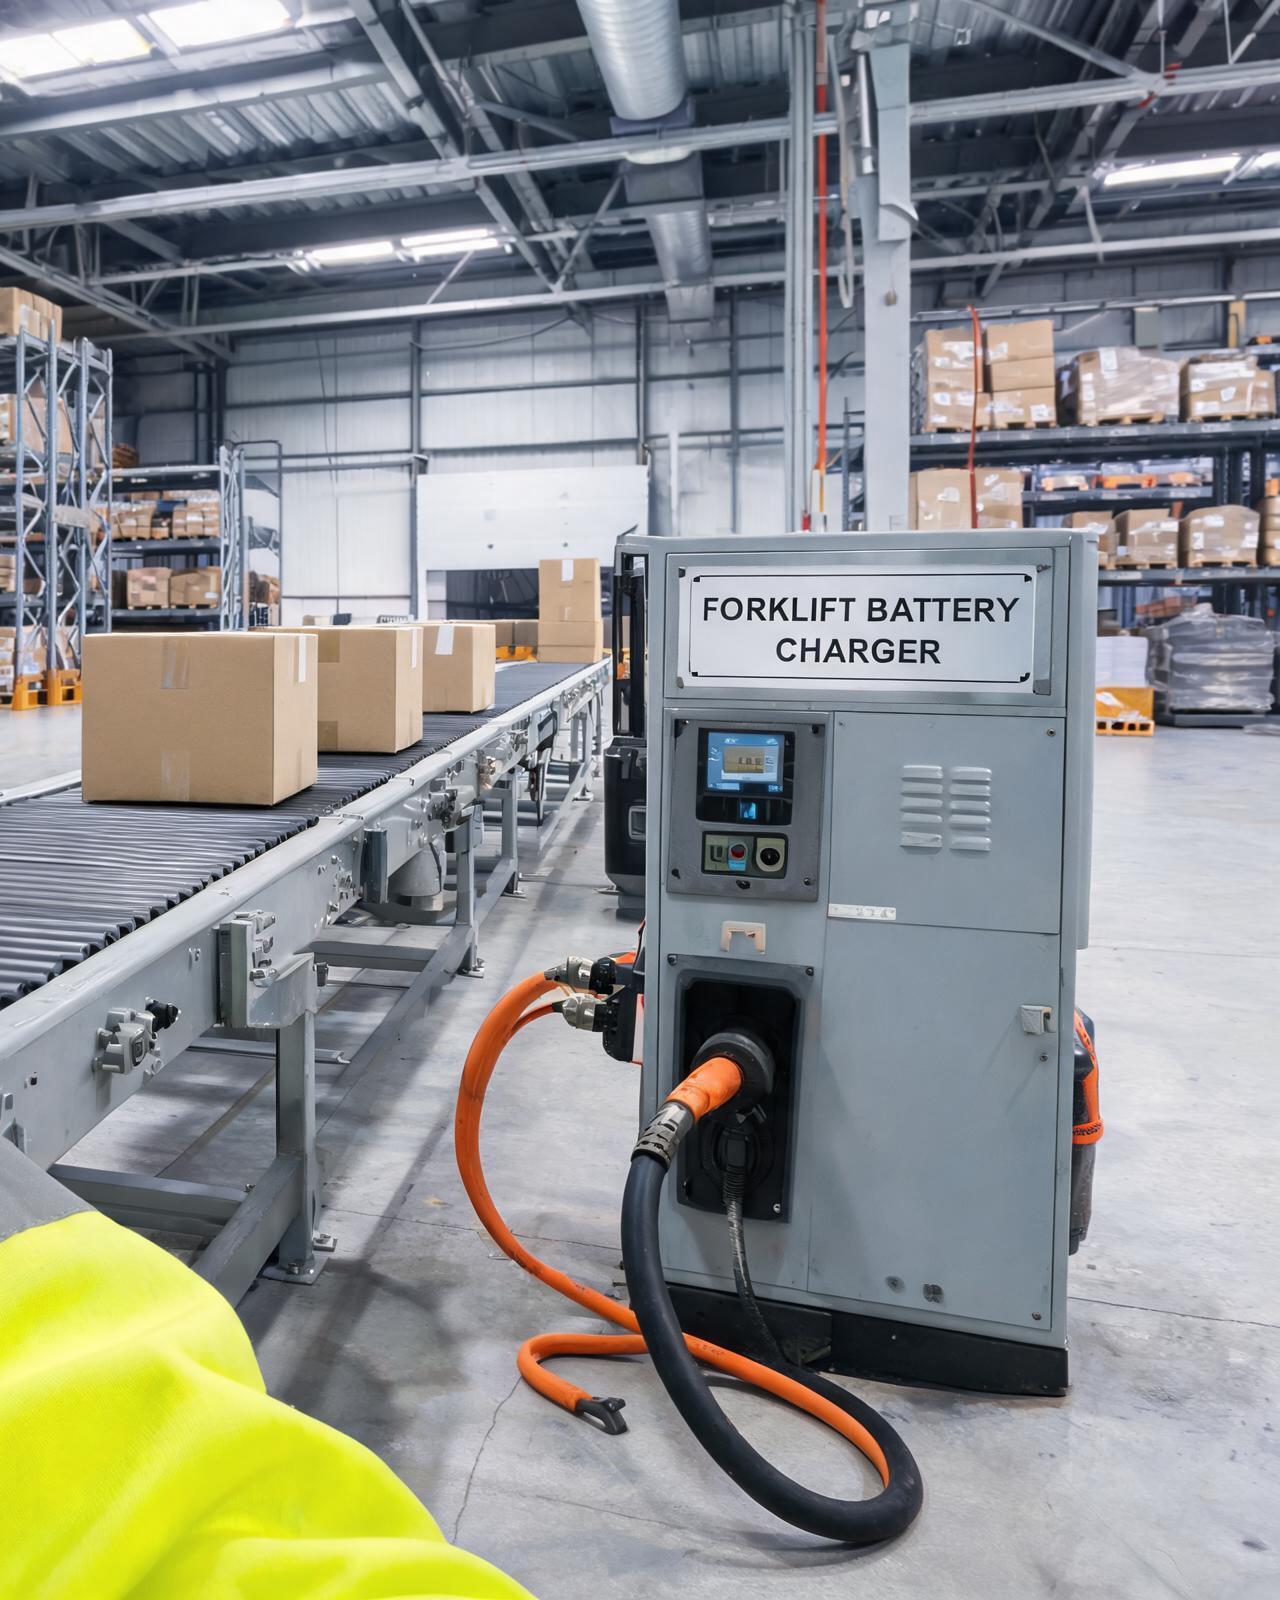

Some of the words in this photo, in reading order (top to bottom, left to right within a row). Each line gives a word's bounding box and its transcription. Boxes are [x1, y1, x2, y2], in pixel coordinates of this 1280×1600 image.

[703, 597, 856, 622] FORKLIFT
[867, 597, 1020, 623] BATTERY
[776, 637, 941, 665] CHARGER
